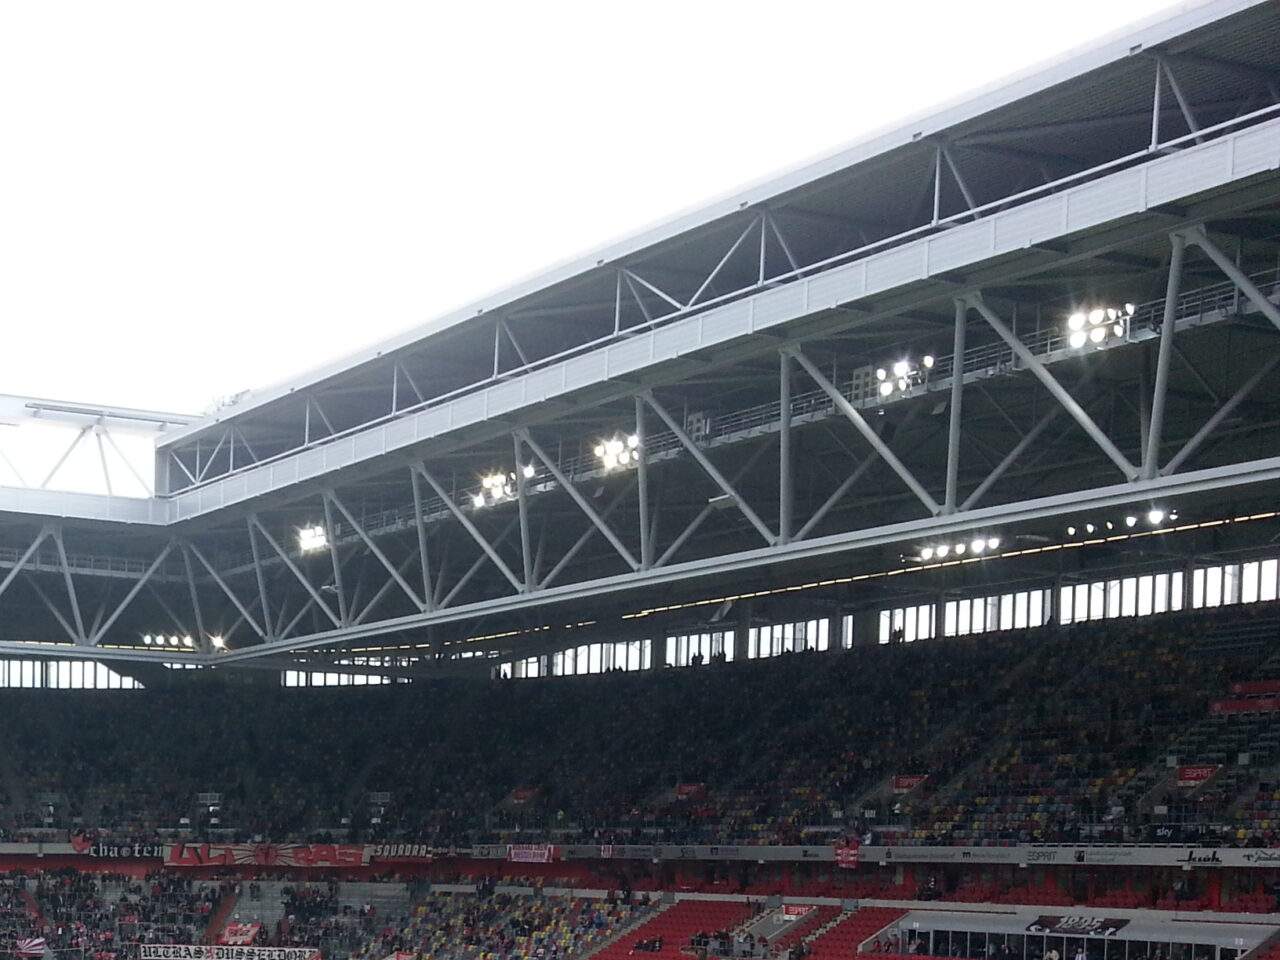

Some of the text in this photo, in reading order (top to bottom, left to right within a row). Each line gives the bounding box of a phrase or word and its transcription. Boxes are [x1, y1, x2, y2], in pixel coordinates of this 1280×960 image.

[1156, 827, 1173, 838] sky
[1027, 851, 1057, 861] ESPRIT
[142, 945, 205, 959] ULTRAS
